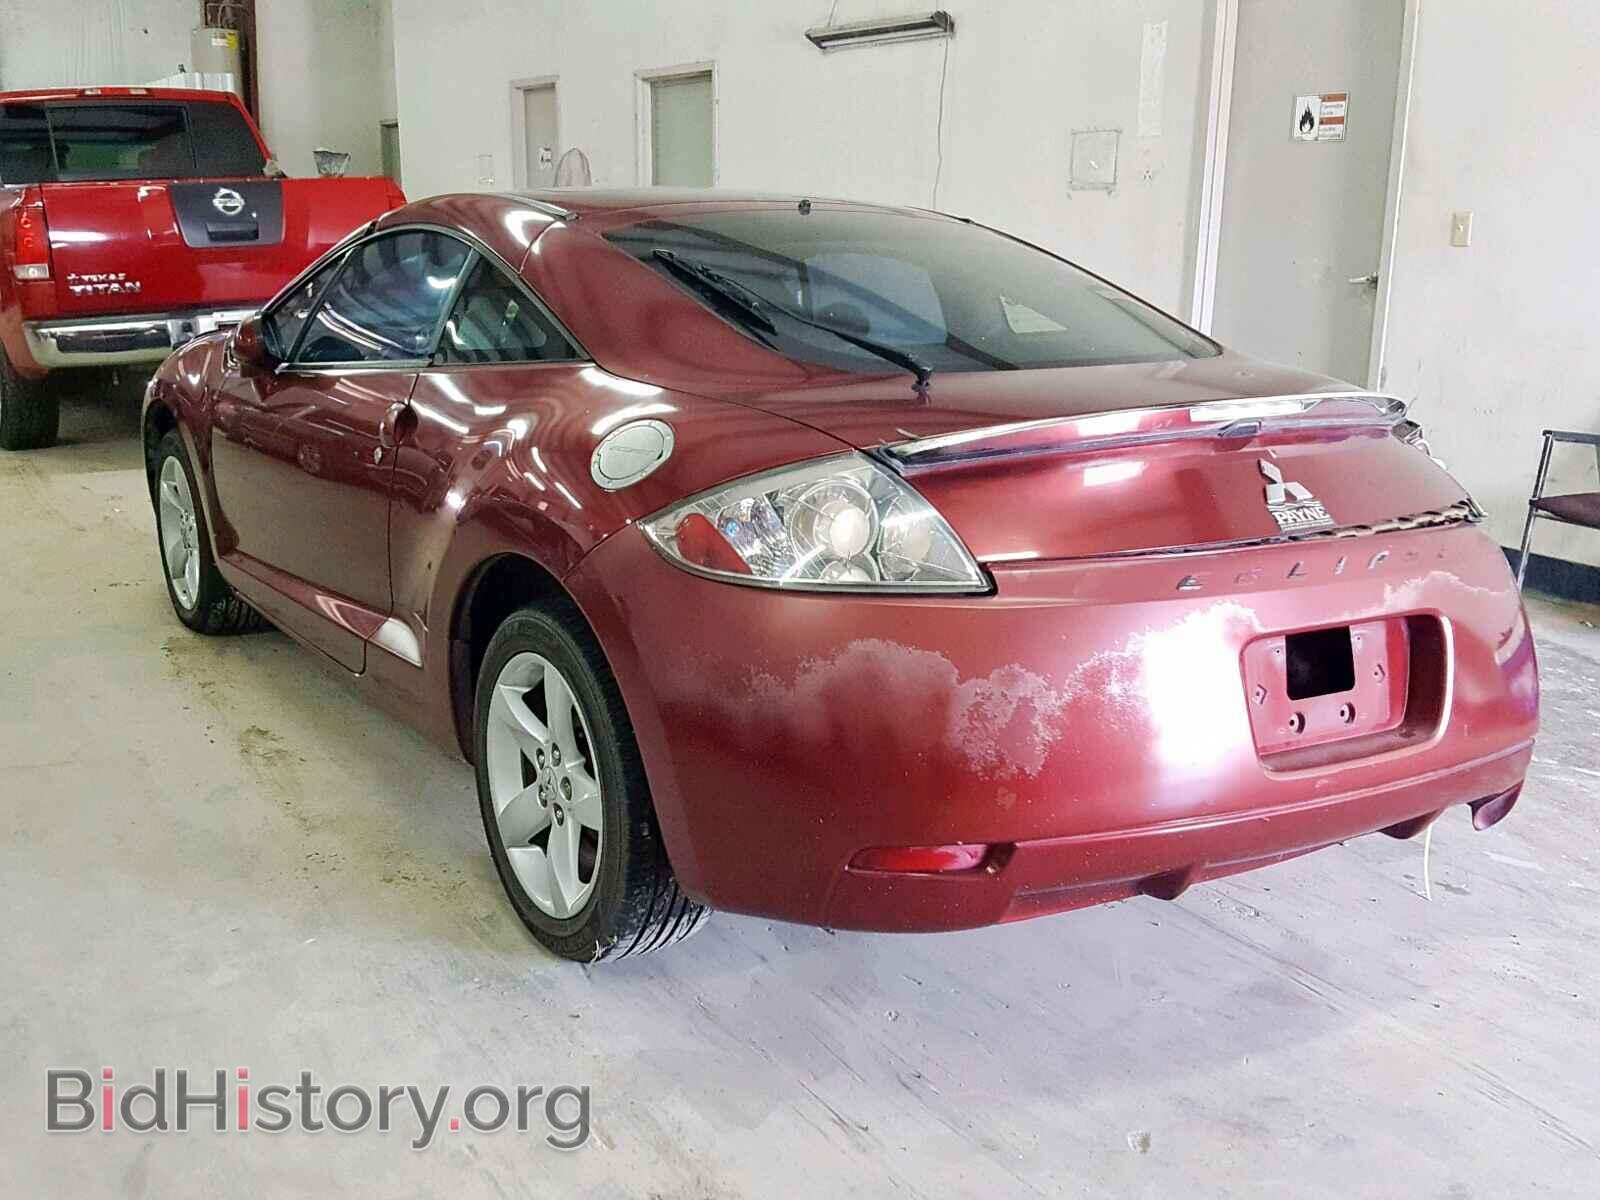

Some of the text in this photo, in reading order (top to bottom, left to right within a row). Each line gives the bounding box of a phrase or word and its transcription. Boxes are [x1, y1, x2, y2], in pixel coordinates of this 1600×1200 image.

[68, 280, 141, 296] TITAN
[1271, 505, 1332, 525] PAYNE
[1175, 545, 1448, 592] ECLIP
